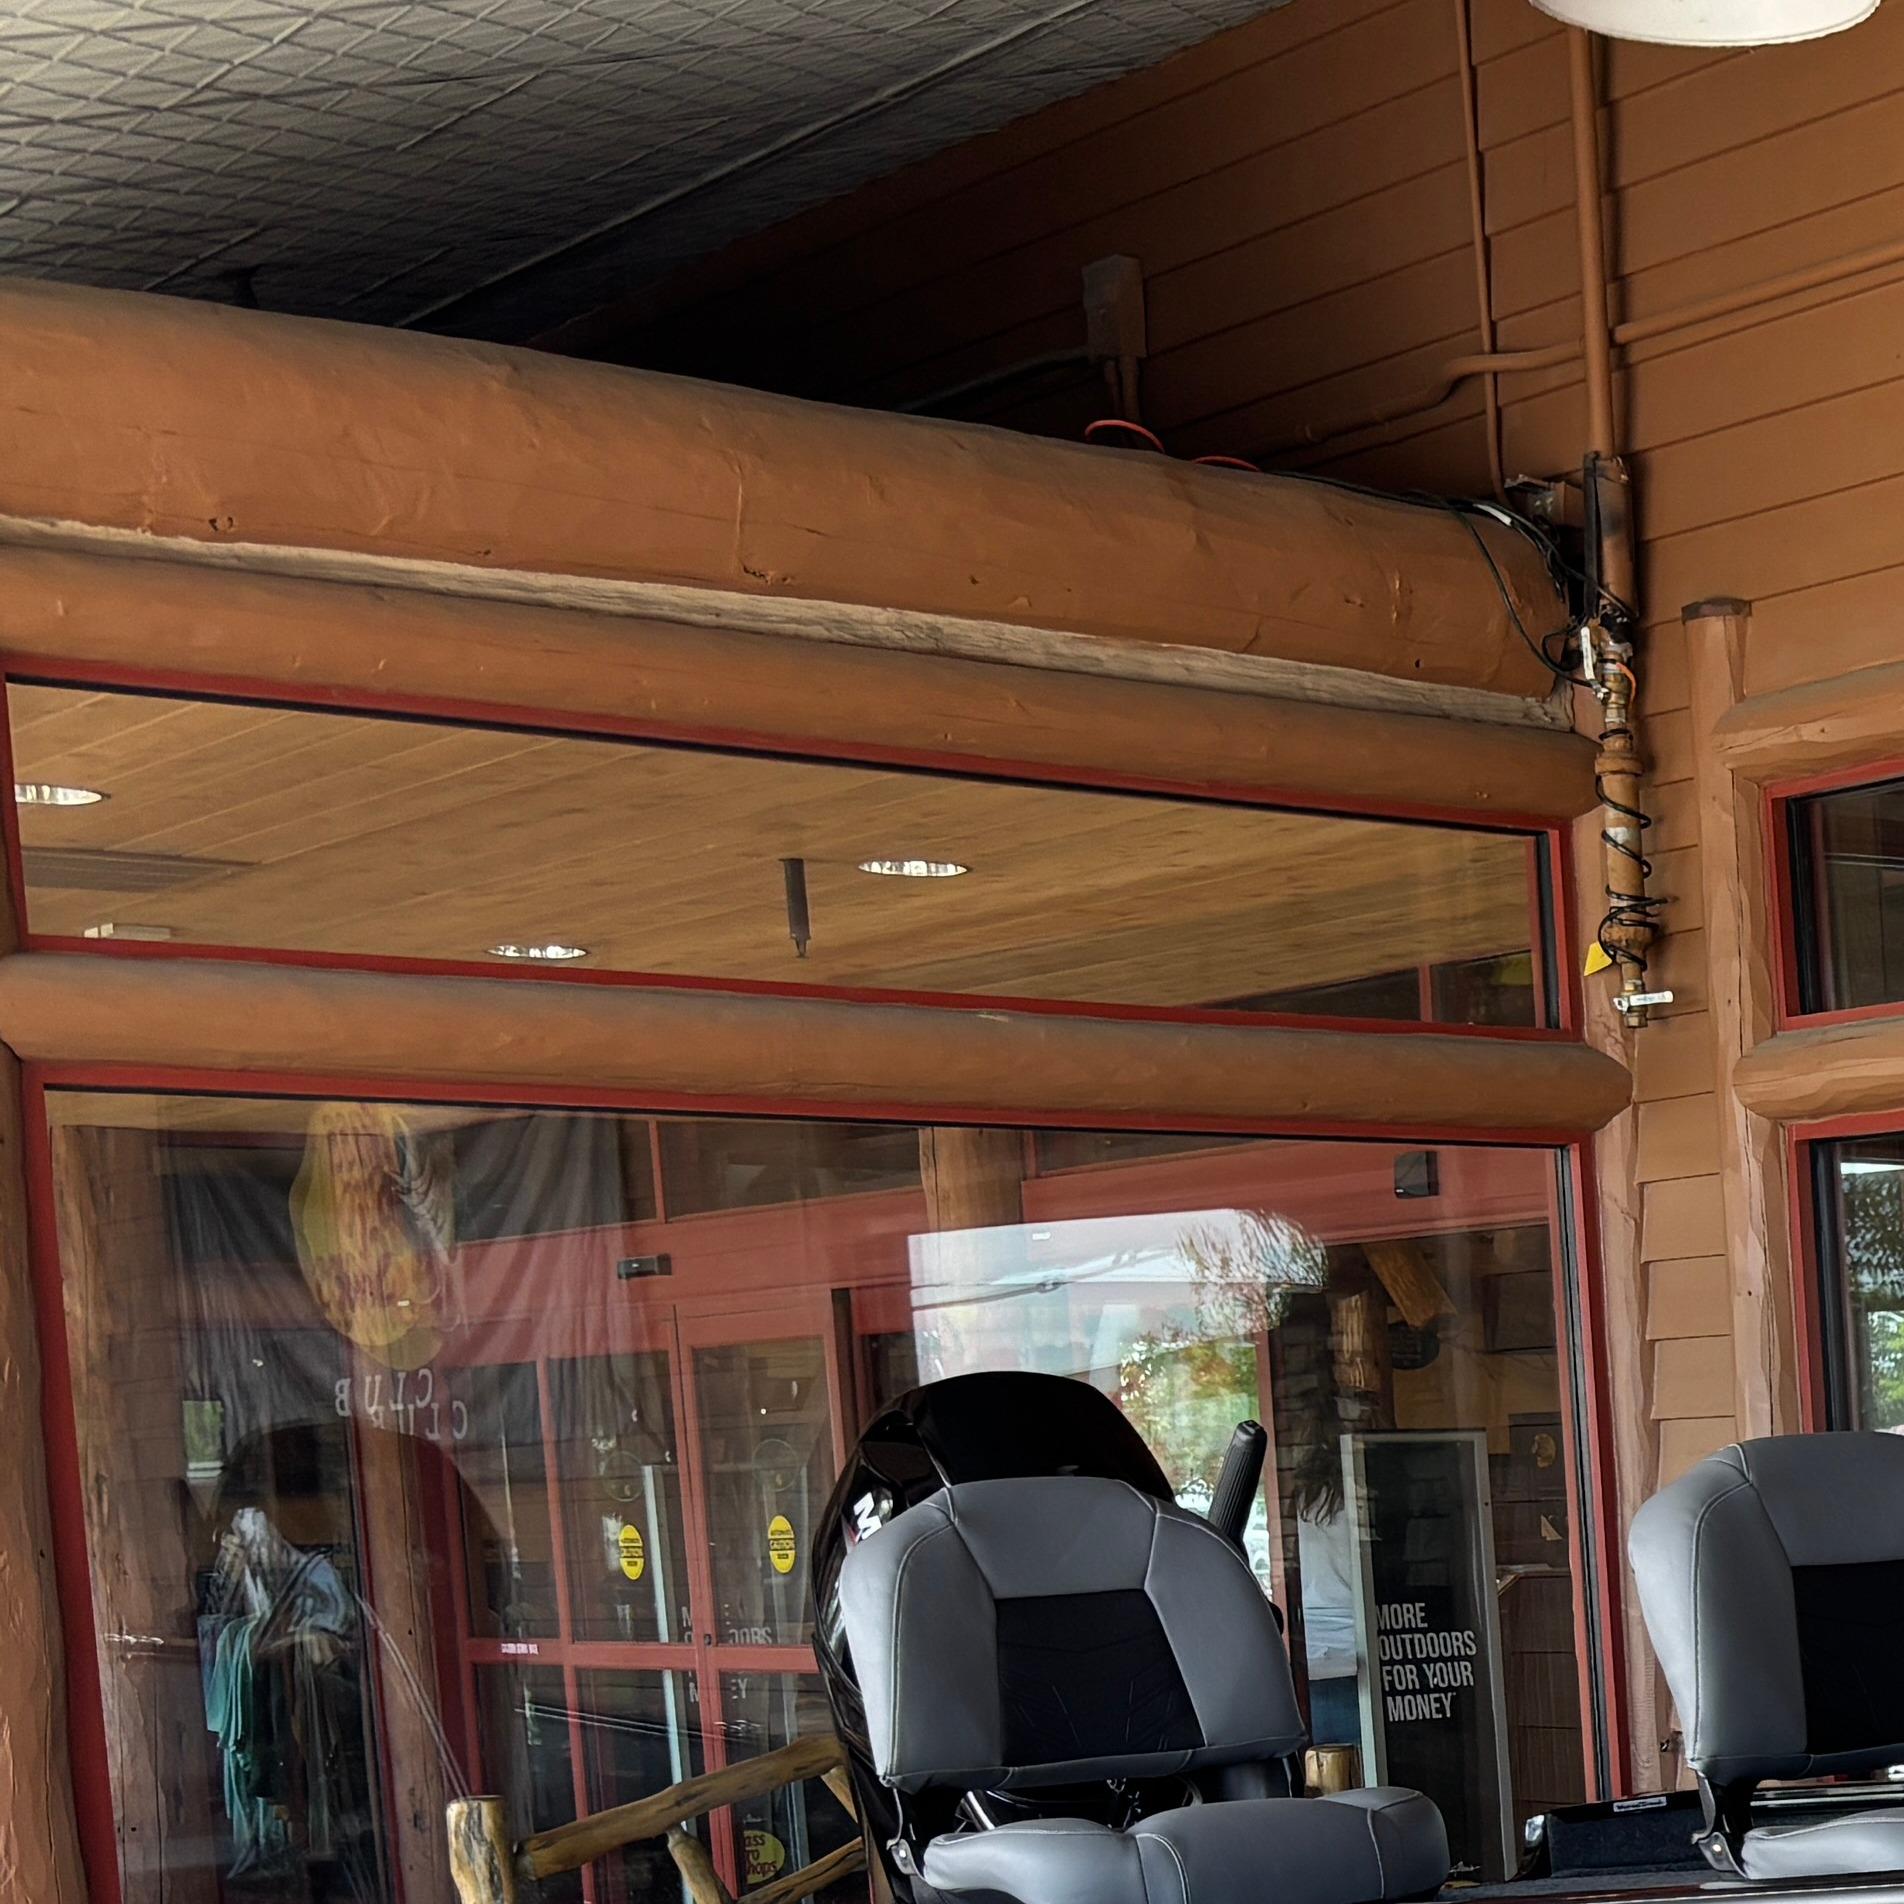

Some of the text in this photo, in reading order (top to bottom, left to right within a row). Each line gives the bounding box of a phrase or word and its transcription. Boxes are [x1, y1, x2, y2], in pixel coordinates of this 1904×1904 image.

[1376, 1602, 1428, 1630] MORE
[1379, 1630, 1477, 1660] OUTDOORS
[1382, 1661, 1474, 1691] FOR YOUR
[1386, 1692, 1452, 1722] MONEY
